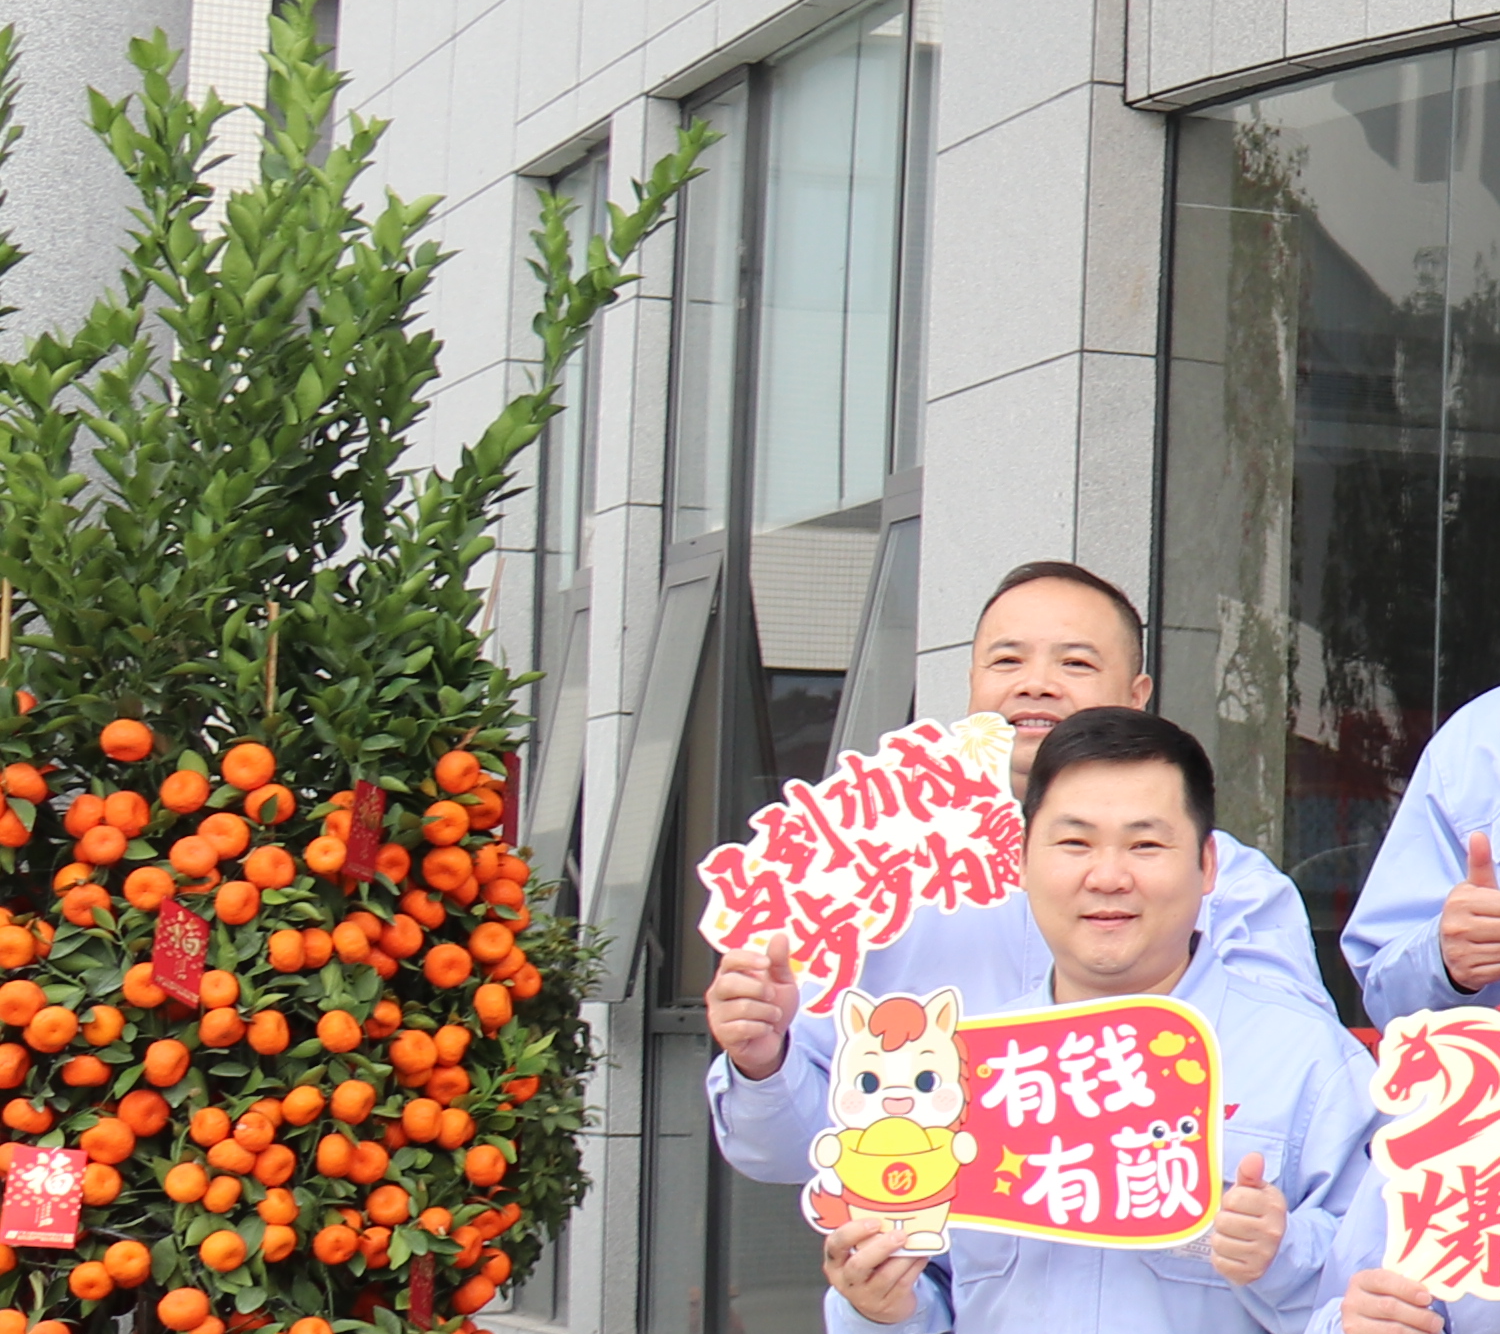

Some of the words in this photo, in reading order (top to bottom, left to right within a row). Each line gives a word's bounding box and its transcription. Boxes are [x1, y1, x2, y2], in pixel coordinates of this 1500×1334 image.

[704, 724, 1001, 949] 马到功成
[166, 910, 201, 957] 福
[980, 1022, 1155, 1128] 有钱
[21, 1152, 75, 1196] 福
[1022, 1125, 1204, 1225] 有颜
